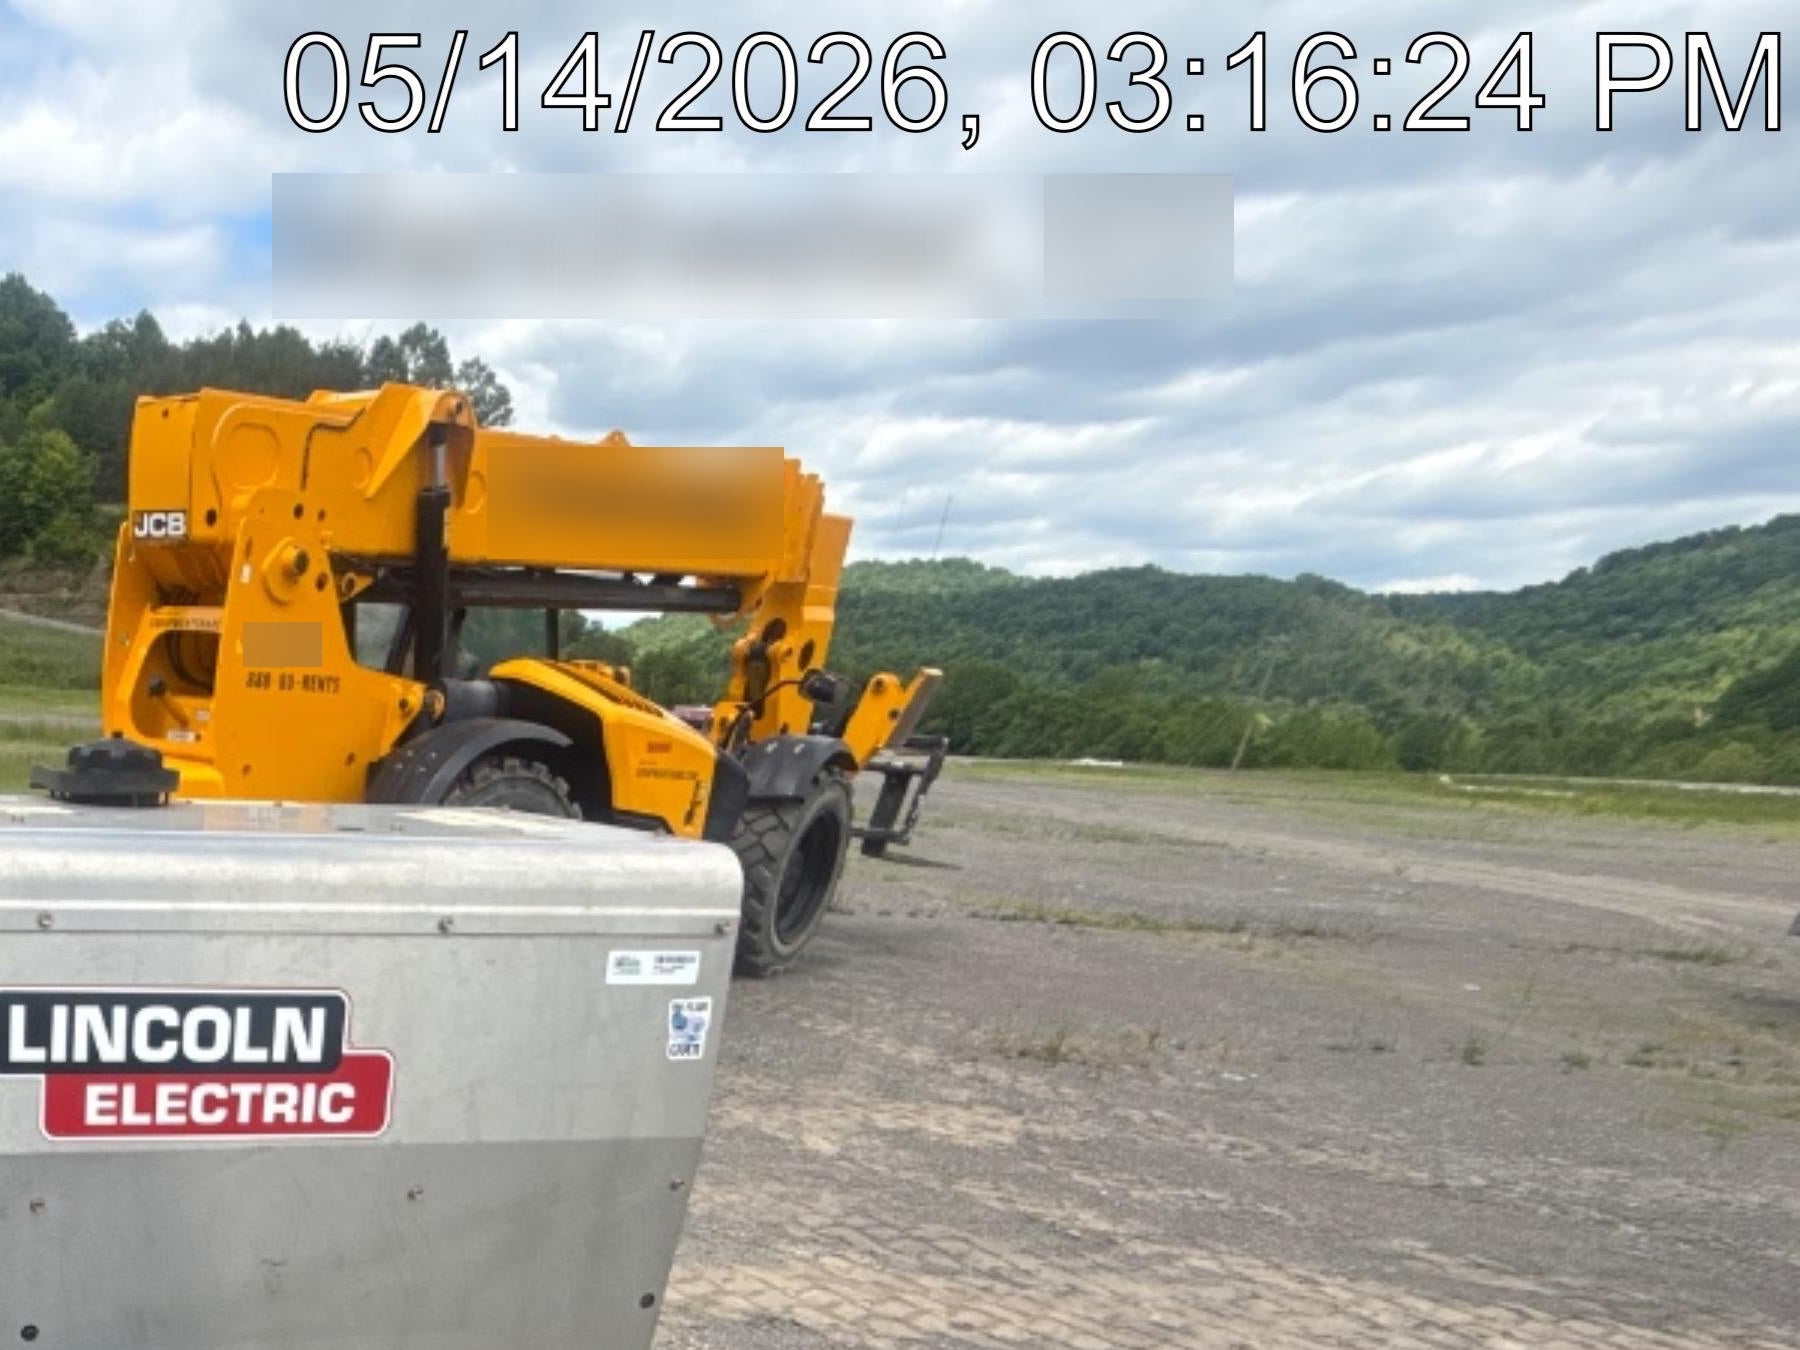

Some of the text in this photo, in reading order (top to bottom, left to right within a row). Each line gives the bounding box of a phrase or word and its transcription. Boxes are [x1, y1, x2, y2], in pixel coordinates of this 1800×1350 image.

[134, 511, 186, 538] JCB
[7, 1004, 326, 1064] LINCOLN
[84, 1082, 356, 1126] ELECTRIC
